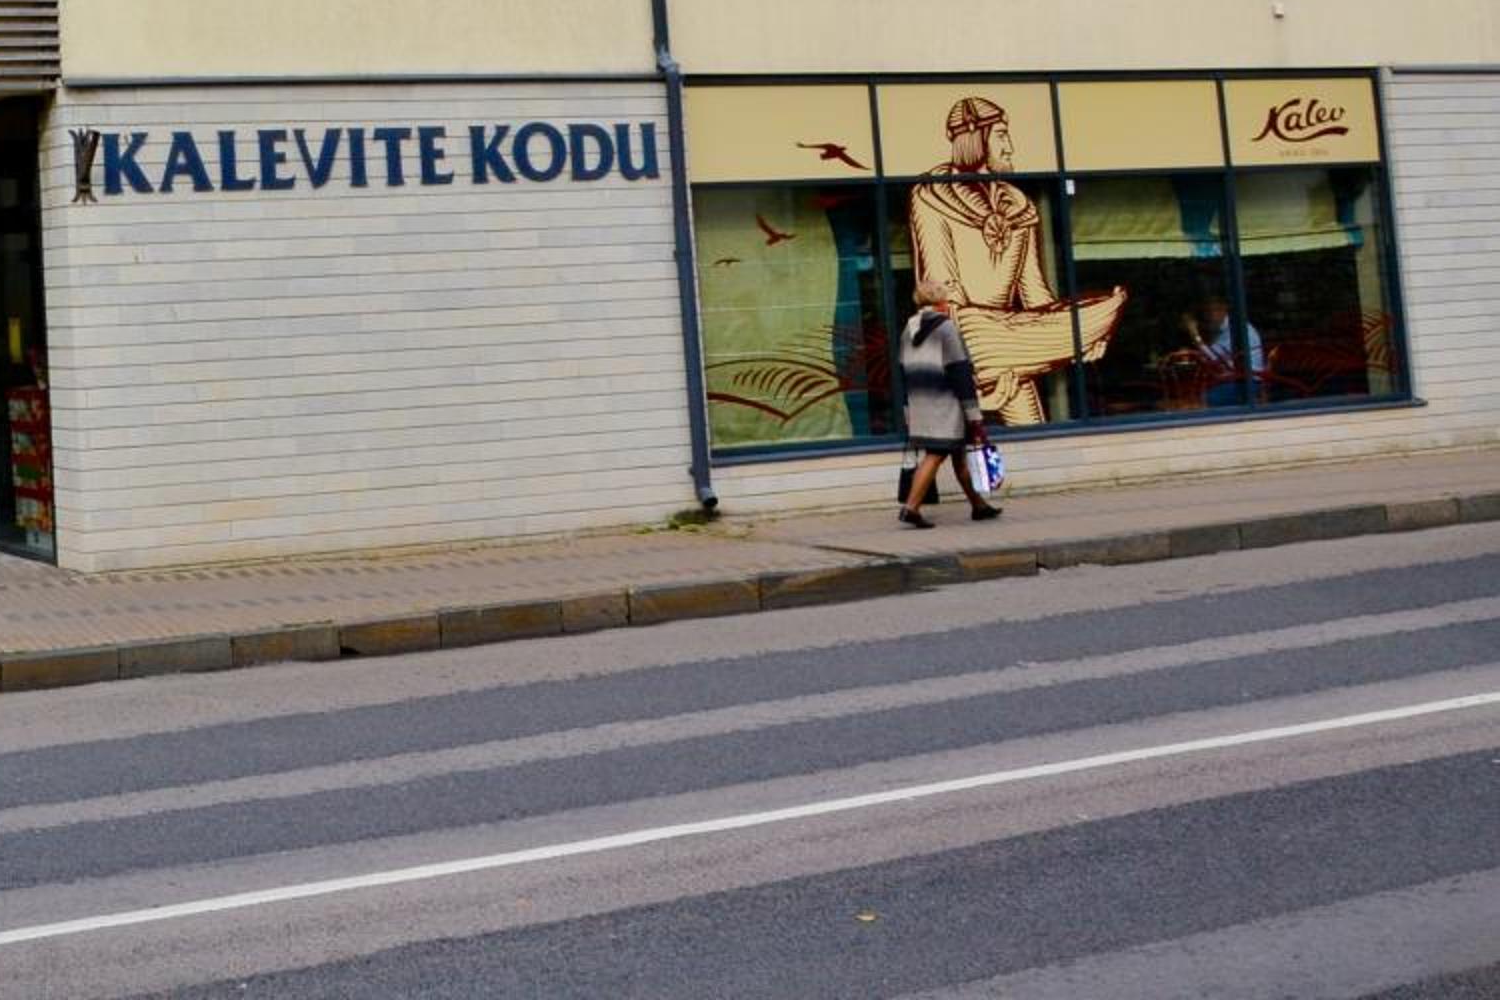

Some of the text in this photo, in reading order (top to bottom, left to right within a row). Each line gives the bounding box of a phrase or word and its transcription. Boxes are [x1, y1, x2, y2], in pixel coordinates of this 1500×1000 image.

[1252, 98, 1349, 143] Kalev
[102, 121, 660, 195] KALEVITE KODU
